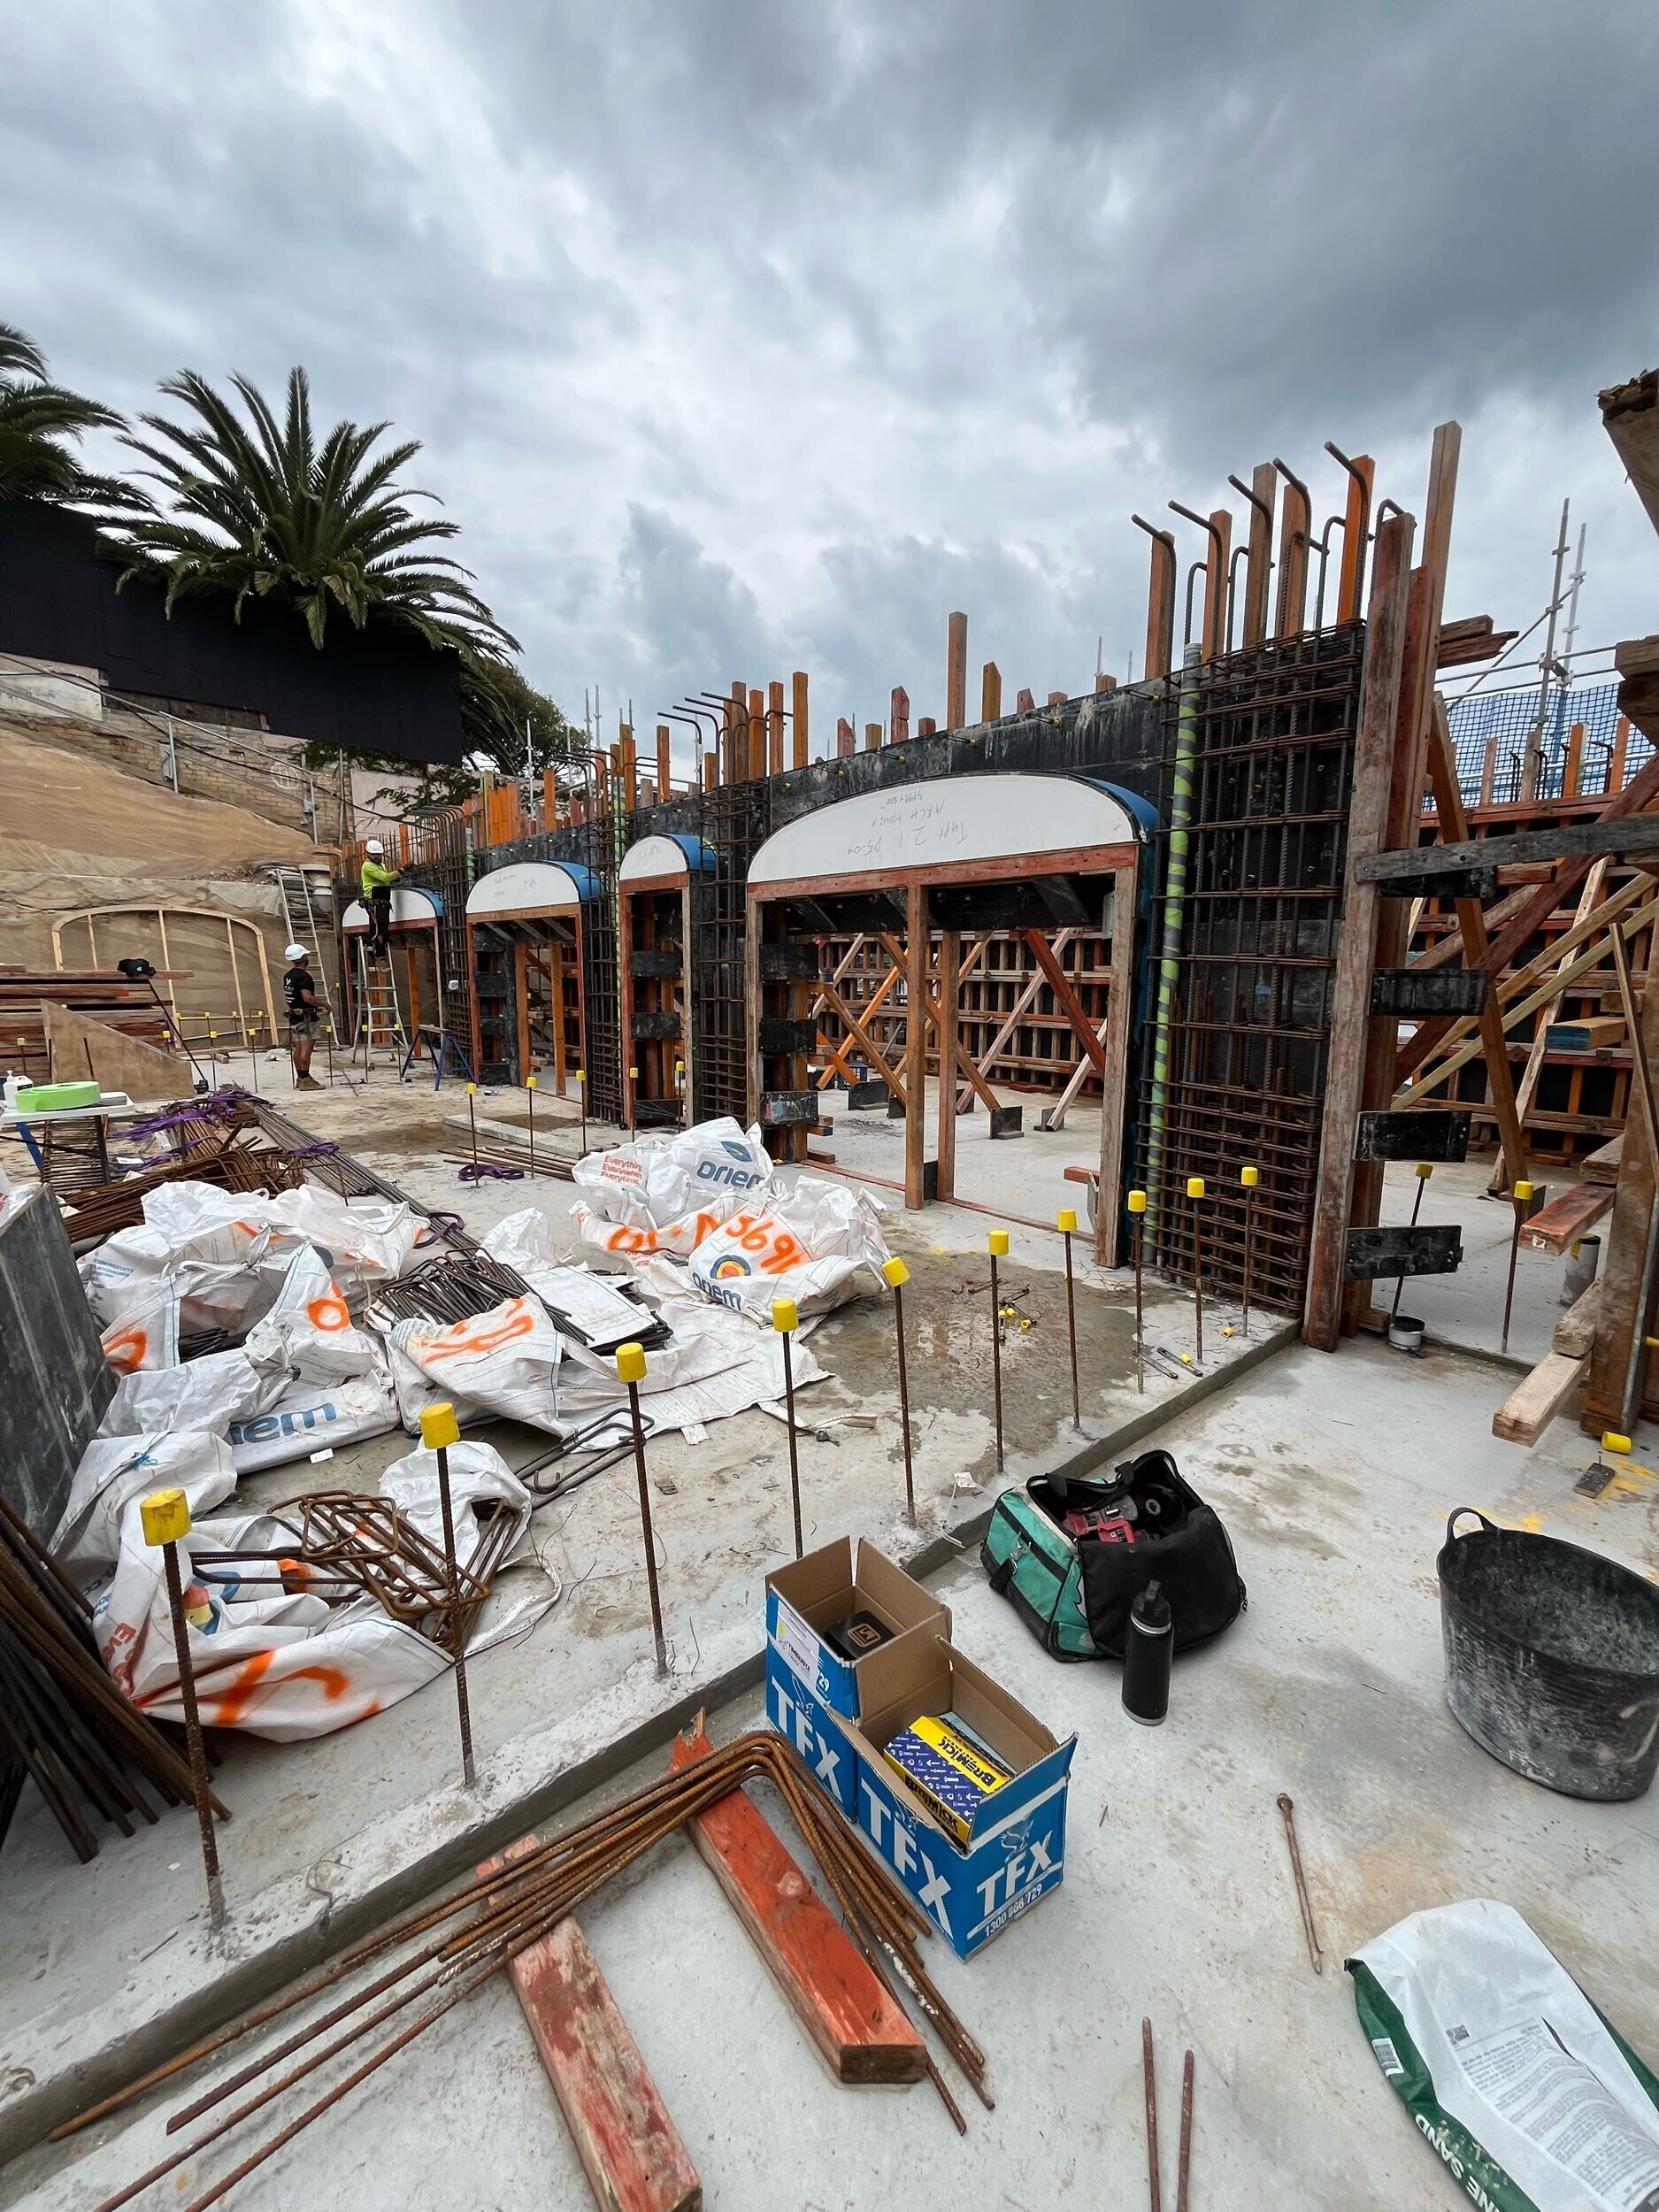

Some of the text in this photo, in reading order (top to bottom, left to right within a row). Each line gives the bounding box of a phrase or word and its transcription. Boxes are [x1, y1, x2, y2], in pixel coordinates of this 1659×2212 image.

[817, 1670, 831, 1693] 29
[772, 1675, 852, 1803] TFX
[938, 1738, 996, 1787] BREMICK
[861, 1778, 951, 1938] TFX
[977, 1830, 1053, 1916] TFX
[986, 1913, 1007, 1937] 1300
[1026, 1884, 1042, 1905] 729
[1416, 2114, 1501, 2212] NE SAND
